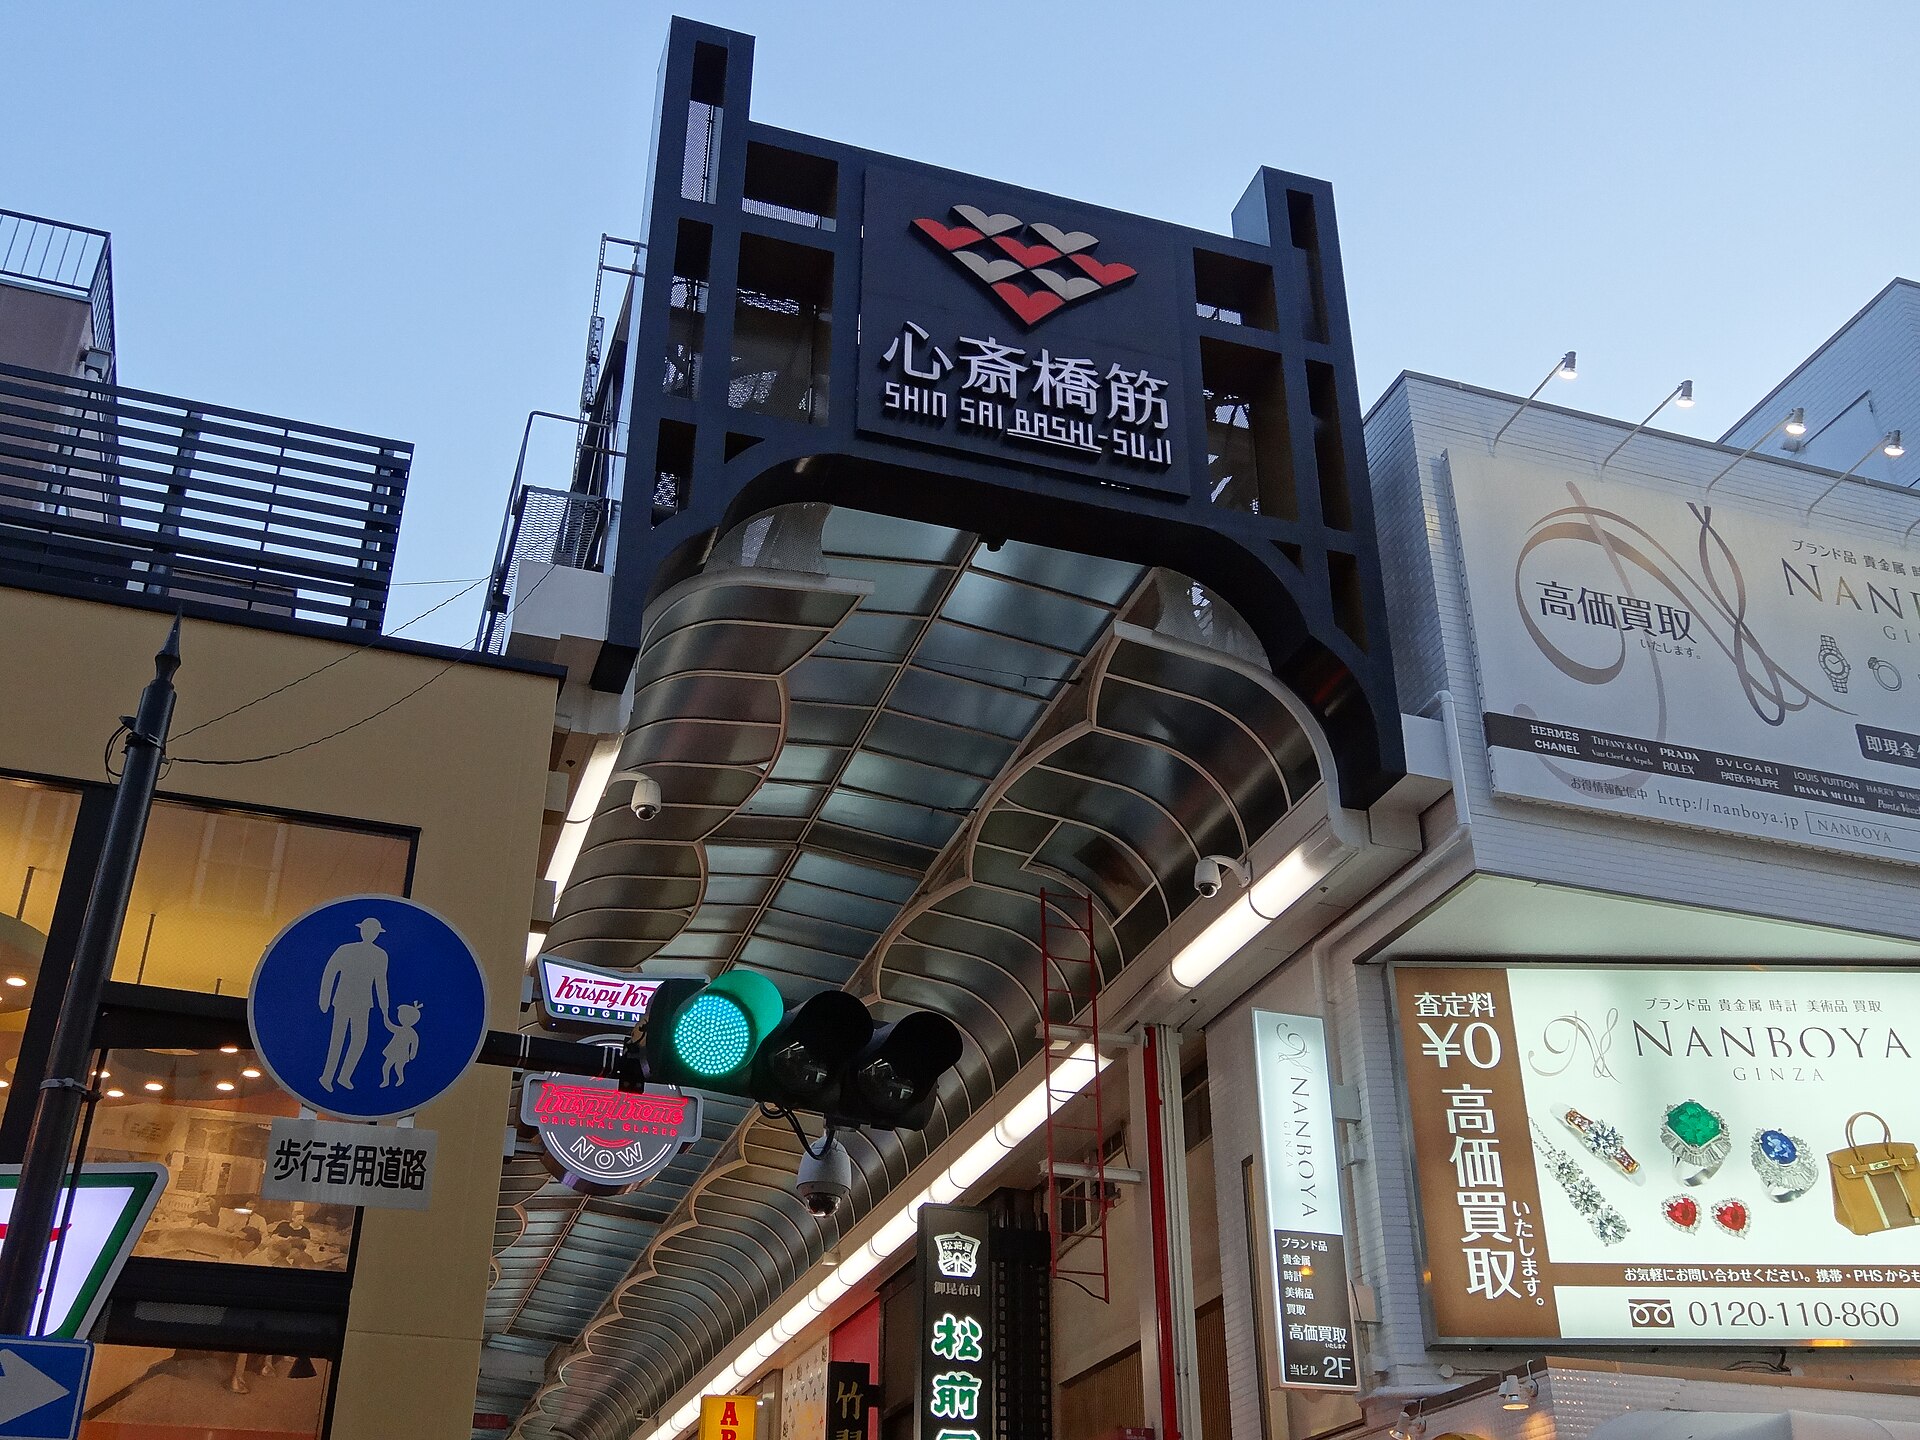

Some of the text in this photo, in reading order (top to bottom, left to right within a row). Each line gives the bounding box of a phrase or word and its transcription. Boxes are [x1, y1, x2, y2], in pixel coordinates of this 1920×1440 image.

[883, 320, 1169, 430] 心斎橋筋
[885, 381, 947, 418] SHIN
[960, 397, 1003, 430] SAI
[1791, 539, 1857, 565] ブランド品
[1862, 554, 1906, 576] 貴金属
[1536, 580, 1698, 644] 高価買取
[1640, 638, 1701, 660] いたします。
[1534, 739, 1581, 755] CHANEL
[1659, 746, 1700, 762] PRADA
[1865, 735, 1920, 759] 即現金
[1662, 760, 1696, 775] ROLEX
[1715, 757, 1779, 776] BVLGARI
[1570, 777, 1648, 800] お得情報配信中
[1793, 770, 1860, 791] LOUIS VUITTON
[1866, 784, 1895, 797] HARRY
[1657, 789, 1800, 830] http://nanboya.jp
[1817, 819, 1892, 843] NANBOYA
[555, 975, 626, 1008] Krispy
[1413, 991, 1496, 1018] 査定料
[1644, 997, 1884, 1013] ブランド品 貴金属 時計 美術品 買取
[1418, 1022, 1502, 1070] ¥0
[1632, 1019, 1912, 1059] NANBOYA
[1732, 1066, 1825, 1082] GINZA
[534, 1082, 619, 1123] Krispy
[540, 1115, 678, 1137] ORIGINAL GLAZED
[570, 1135, 644, 1170] NOW
[1283, 1120, 1294, 1168] GINZA
[1290, 1076, 1318, 1217] NANBOYA
[273, 1138, 428, 1191] 歩行者用道路
[1441, 1083, 1522, 1300] 高価買取
[1281, 1237, 1328, 1252] ブランド品
[1511, 1199, 1545, 1306] いたします。
[1282, 1253, 1311, 1267] 貴金属
[1283, 1270, 1303, 1283] 時計
[1284, 1286, 1315, 1300] 美術品
[1286, 1303, 1307, 1316] 買取
[1688, 1301, 1900, 1328] 0120-110-860
[1288, 1323, 1348, 1344] 高価買取
[931, 1313, 983, 1440] 松前
[1289, 1356, 1352, 1379] 当ビル 2F
[835, 1380, 864, 1440] 竹
